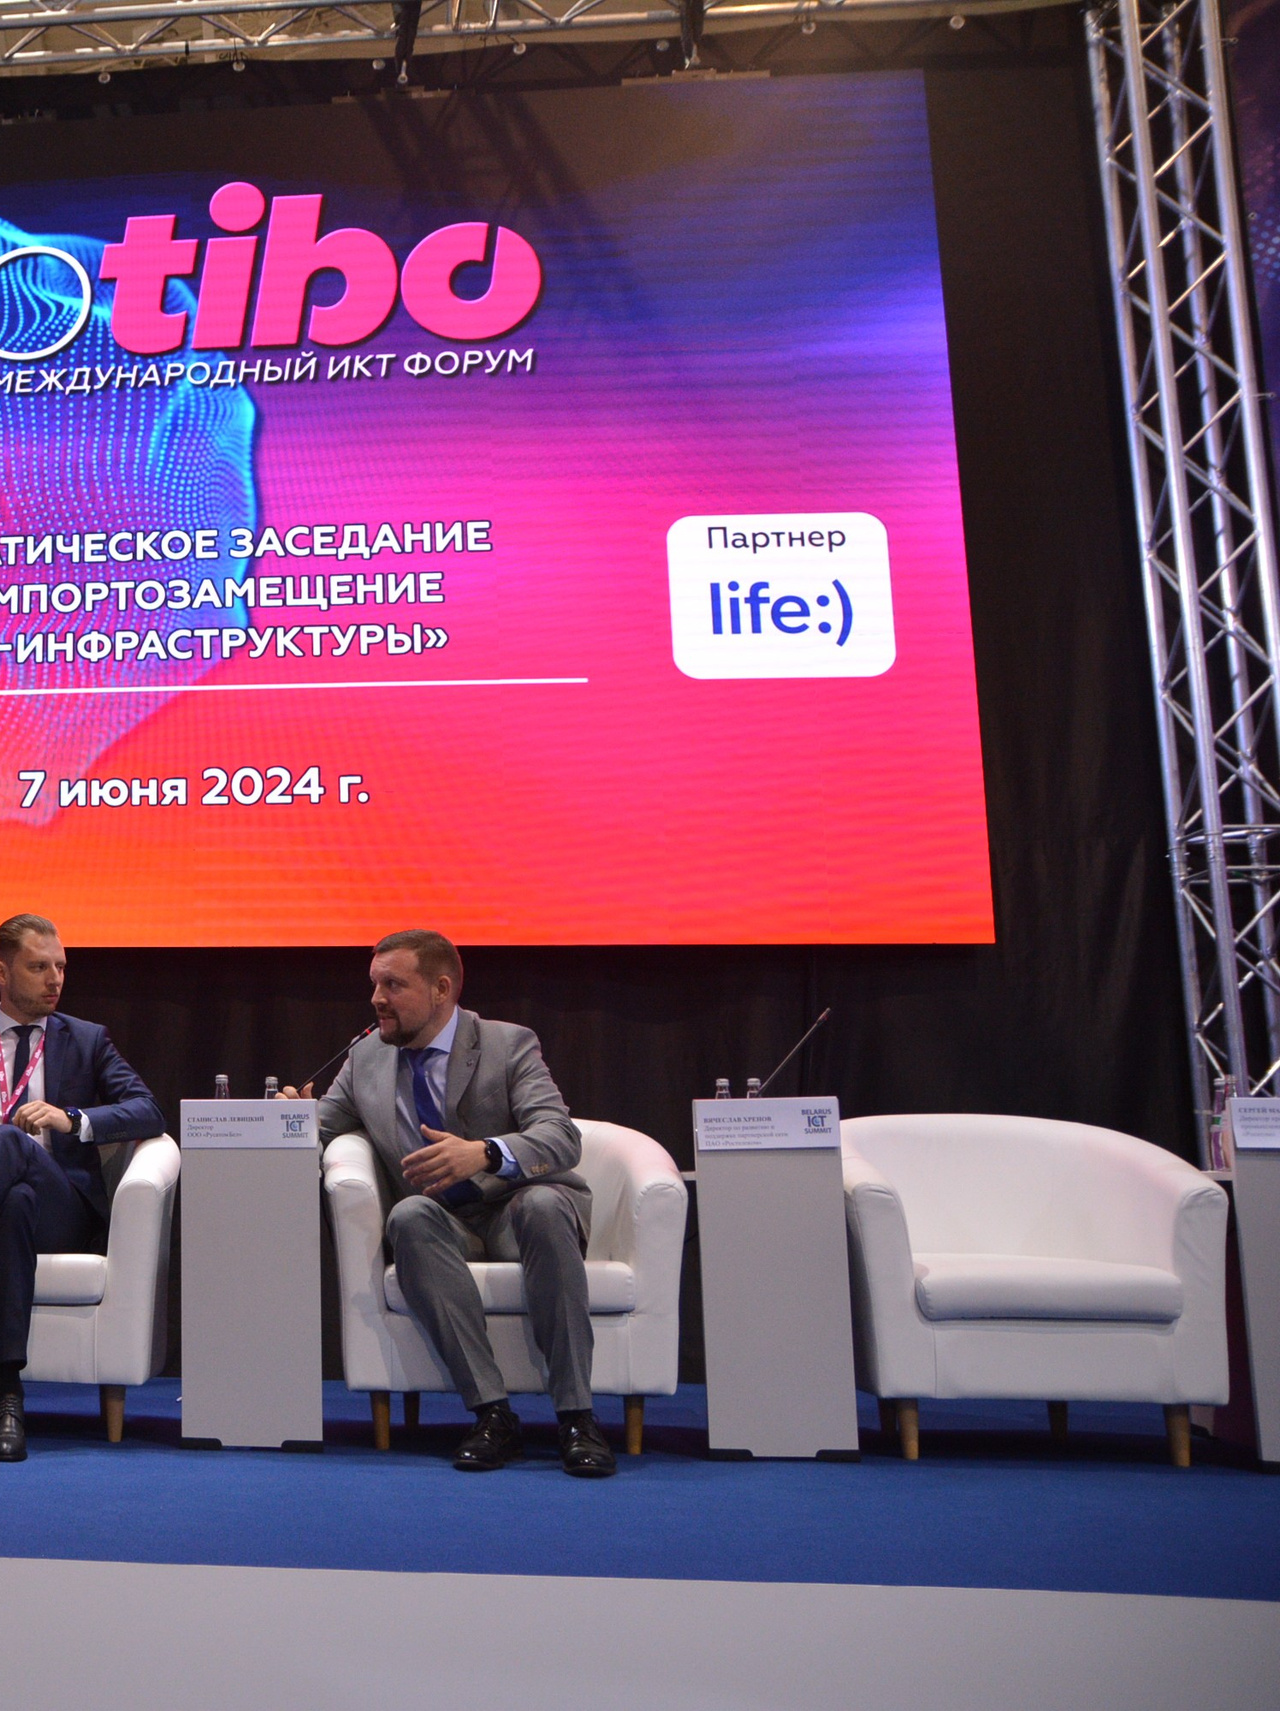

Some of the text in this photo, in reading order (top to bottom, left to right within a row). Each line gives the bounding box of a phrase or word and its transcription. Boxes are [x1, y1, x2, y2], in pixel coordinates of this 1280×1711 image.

[99, 181, 542, 354] tibo
[327, 354, 391, 382] ИКТ
[403, 348, 535, 378] ФОРУМ
[229, 520, 493, 562] ЗАСЕДАНИЕ
[707, 526, 847, 554] Партнер
[17, 766, 371, 809] 7 июня 2024 г.
[286, 1120, 304, 1132] ICT
[807, 1115, 827, 1127] ICT
